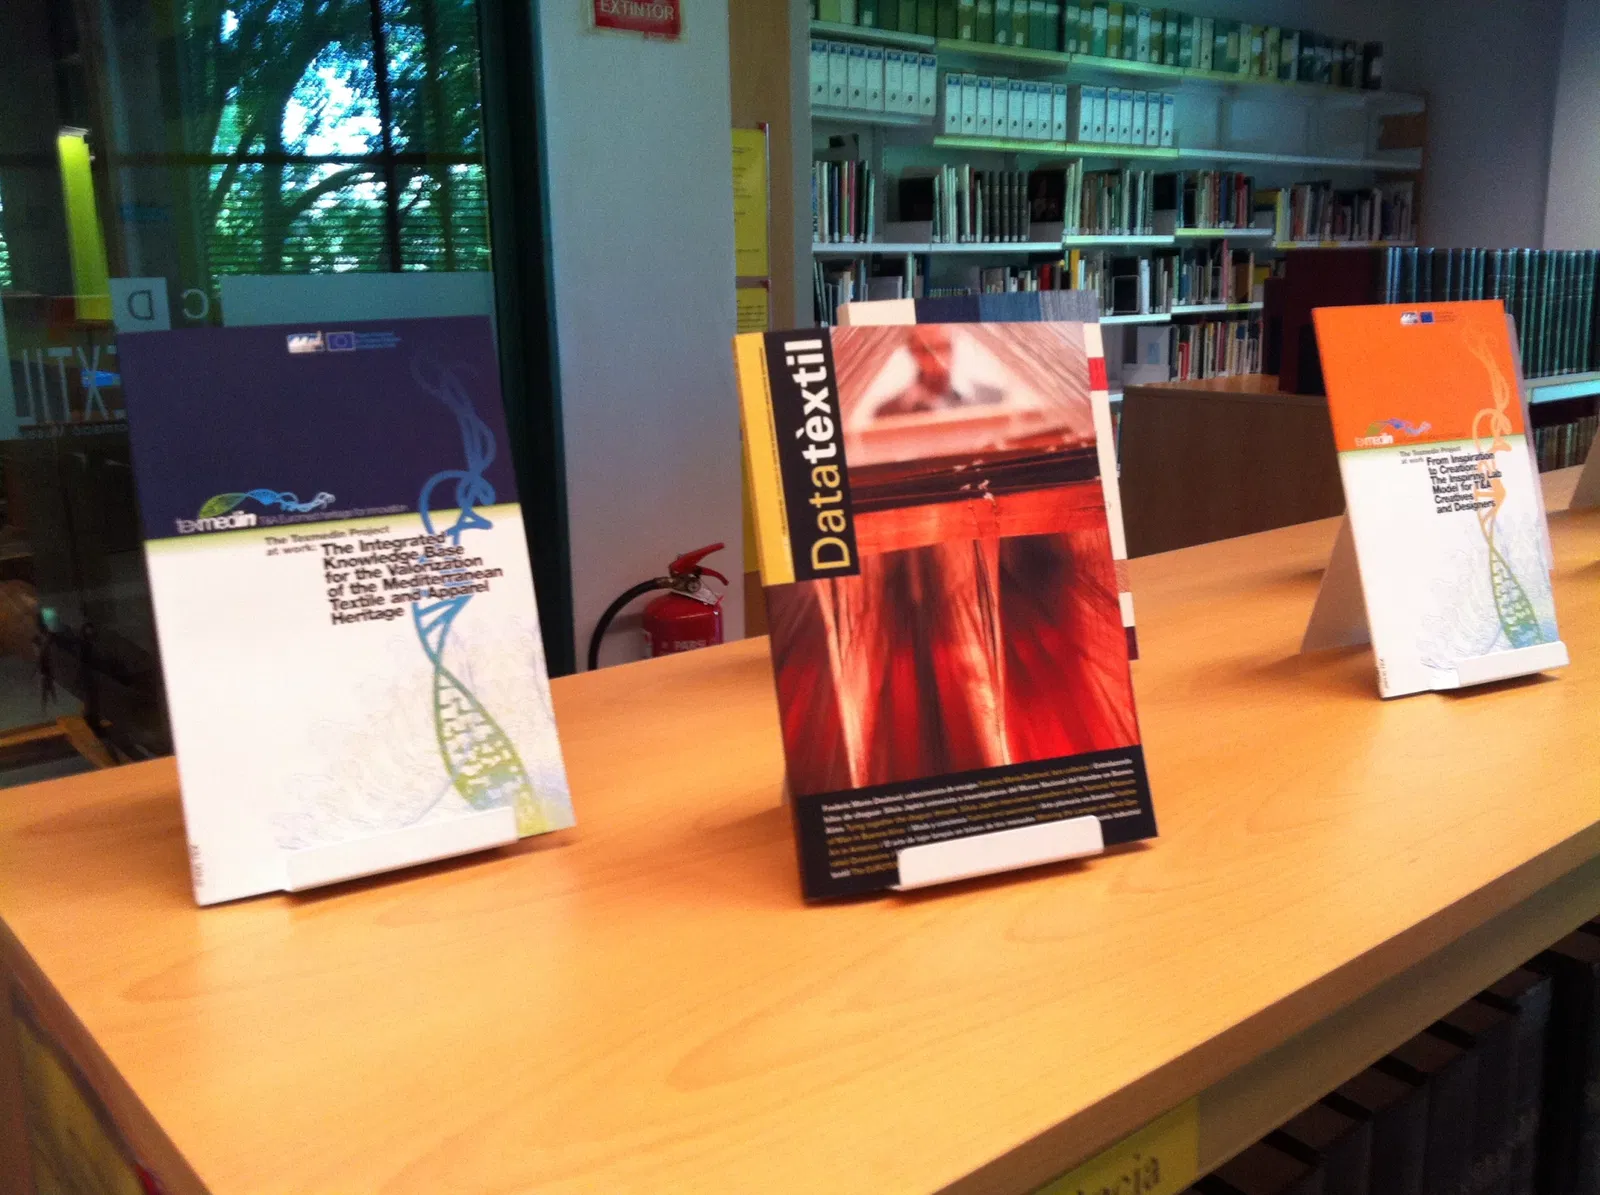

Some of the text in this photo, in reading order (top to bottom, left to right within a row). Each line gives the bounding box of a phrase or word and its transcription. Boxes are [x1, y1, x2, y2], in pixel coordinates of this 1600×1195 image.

[600, 0, 674, 20] EXTINTOR
[784, 339, 851, 570] Datatèxtil
[1426, 452, 1495, 466] From Inspiration
[1428, 467, 1438, 475] to
[1430, 469, 1502, 485] The Inspiring Lab
[1432, 484, 1459, 494] Model
[1460, 482, 1472, 491] for
[1434, 493, 1474, 504] Creatives
[1436, 500, 1496, 514] and Designers
[349, 526, 391, 539] Project
[320, 531, 447, 556] The Integrated
[322, 545, 465, 570] Knowledge Base
[324, 556, 484, 583] for the Valorization
[326, 567, 504, 597] of the Mediterranean
[329, 580, 491, 611] Textile and Apparel
[330, 606, 406, 625] Heritage
